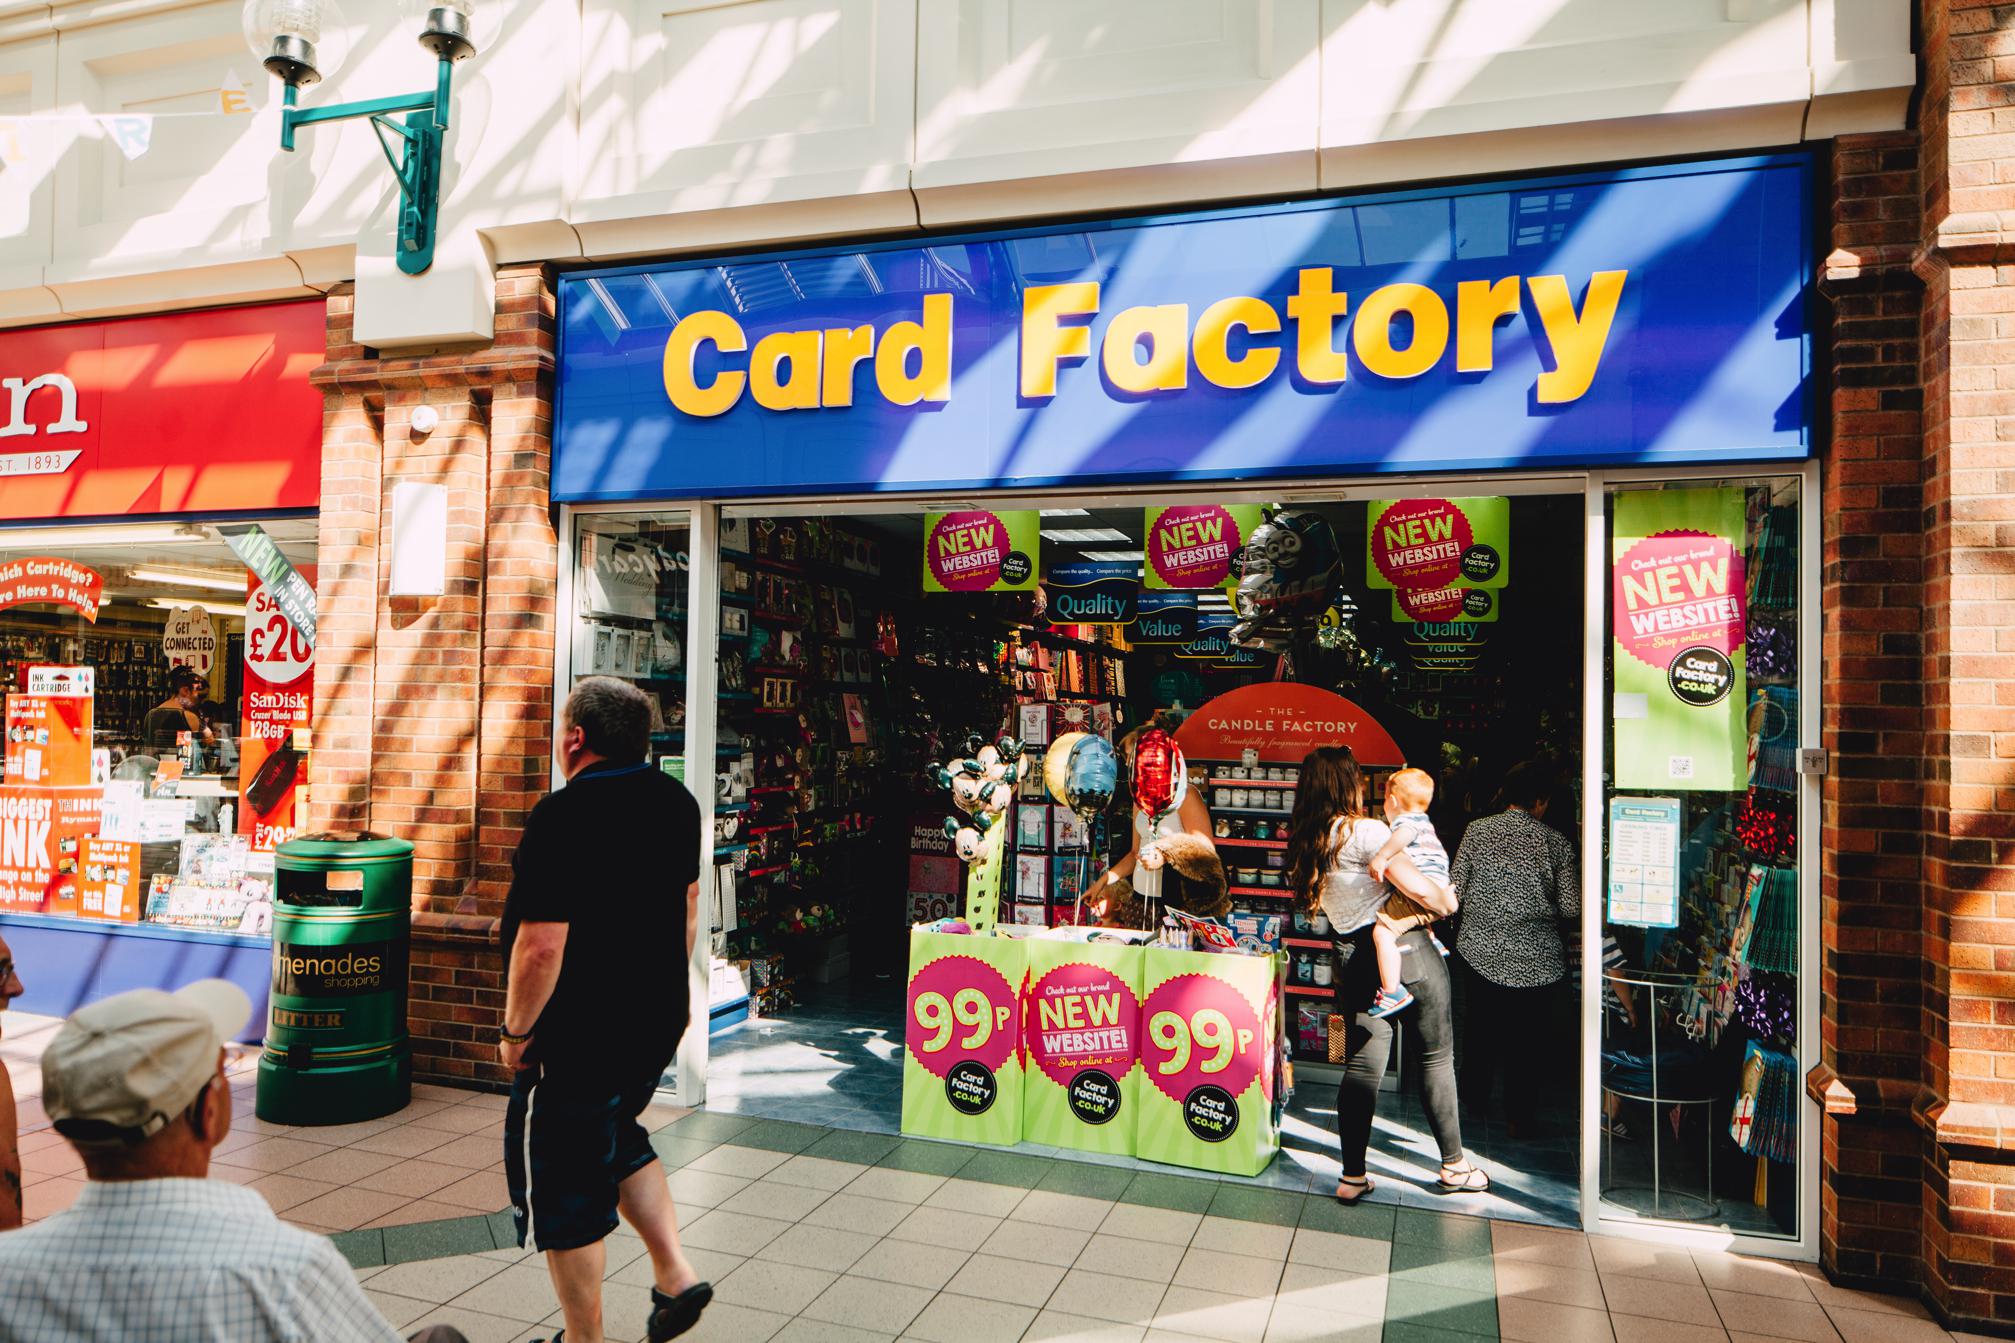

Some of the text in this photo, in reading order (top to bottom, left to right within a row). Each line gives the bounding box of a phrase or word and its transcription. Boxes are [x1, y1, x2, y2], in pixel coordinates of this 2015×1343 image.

[220, 89, 252, 115] E
[663, 267, 1629, 417] Card Factory
[28, 454, 61, 470] 1893
[937, 524, 995, 557] NEW
[1160, 517, 1223, 552] NEW
[1384, 514, 1453, 550] NEW
[238, 526, 289, 585] NEW
[941, 549, 1000, 572] WEBSITE!
[1163, 543, 1229, 568] WEBSITE!
[1388, 542, 1460, 567] WEBSITE!
[1465, 558, 1495, 569] Factory
[1471, 552, 1489, 560] Card
[1631, 545, 1715, 571] Check out our brand
[26, 561, 93, 587] Cartridge?
[1003, 564, 1028, 574] Factory
[1402, 568, 1419, 577] Shop
[1421, 564, 1440, 574] online
[287, 571, 308, 602] PEN
[1622, 557, 1728, 610] NEW
[17, 585, 48, 599] Here
[51, 584, 65, 598] To
[67, 587, 96, 613] Help.
[256, 592, 281, 612] SA
[1408, 588, 1463, 606] WEBSITE!
[274, 585, 315, 636] IN STORE
[1057, 593, 1126, 620] Quality
[1629, 597, 1740, 635] WEBSITE!
[175, 622, 190, 634] GET
[1139, 619, 1182, 636] Value
[1413, 621, 1478, 641] Quality
[165, 637, 214, 651] CONNECTED
[1181, 636, 1230, 655] Quality
[1652, 628, 1722, 648] Shop online at
[1686, 658, 1718, 672] Card
[32, 673, 44, 682] INK
[1675, 666, 1728, 687] Factory
[32, 683, 71, 692] CARTRIDGE
[1677, 680, 1717, 695] .co.uk
[250, 692, 309, 708] SanDisk
[251, 710, 306, 720] Cruzer Blade USB
[1269, 707, 1293, 716] THE
[250, 721, 285, 739] 128GB
[1208, 719, 1358, 733] CANDLE FACTORY
[1219, 734, 1266, 748] Beautifully
[0, 819, 52, 869] NK
[911, 837, 949, 853] Birthday
[21, 871, 32, 882] on
[35, 868, 50, 883] the
[19, 886, 44, 902] Street
[913, 897, 949, 921] 50
[324, 974, 380, 989] shopping
[1046, 985, 1064, 995] Check
[1078, 985, 1089, 993] our
[1090, 981, 1110, 991] brand
[273, 1008, 343, 1027] LITTER
[1038, 993, 1121, 1030] NEW
[1043, 1029, 1128, 1053] WEBSITE!
[1058, 1055, 1113, 1069] Shop online at
[960, 1071, 984, 1085] Card
[1083, 1080, 1108, 1094] Card
[951, 1078, 990, 1098] Factory
[953, 1090, 982, 1105] .co.uk
[1074, 1087, 1114, 1108] Factory
[1199, 1095, 1225, 1111] Card
[1075, 1099, 1106, 1115] .co.uk
[1190, 1102, 1232, 1125] Factory
[1191, 1116, 1223, 1132] .co.uk
